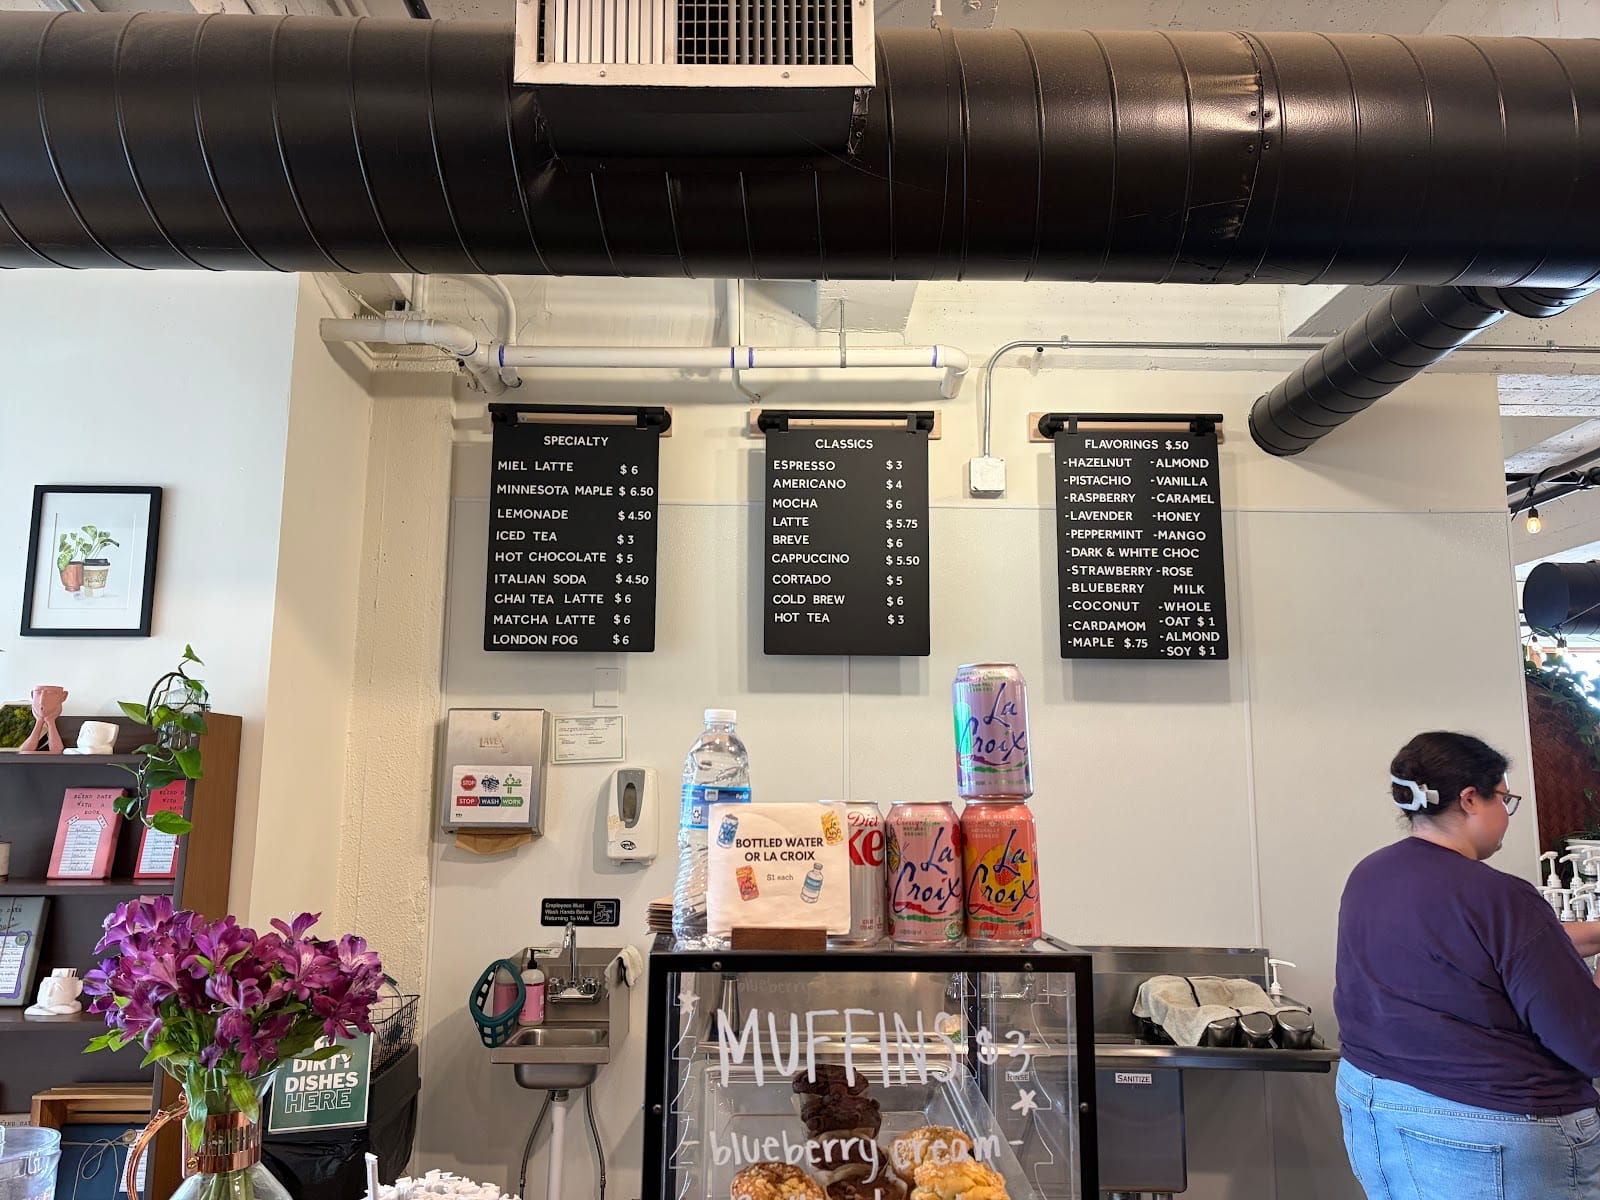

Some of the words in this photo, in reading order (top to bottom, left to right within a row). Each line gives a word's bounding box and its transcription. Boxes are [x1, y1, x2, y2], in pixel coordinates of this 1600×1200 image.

[544, 436, 608, 446] SPECIALTY
[815, 439, 873, 451] CLASSICS
[1085, 439, 1158, 449] FLAVORINGS
[1165, 440, 1189, 450] $.50
[498, 461, 527, 470] MIEL
[535, 461, 573, 471] LATTE
[774, 460, 835, 470] ESPRESSO
[1063, 458, 1132, 467] -HAZELNUT
[1150, 458, 1209, 468] -ALMOND
[773, 479, 846, 489] AMERICANO
[1064, 476, 1131, 485] -PISTACHIO
[1151, 476, 1208, 486] -VANILLA
[497, 485, 569, 495] MINNESOTA
[575, 486, 613, 496] MAPLE
[1064, 493, 1136, 502] -RASPBERRY
[1151, 493, 1214, 504] -CARAMEL
[773, 498, 818, 508] MOCHA
[498, 509, 568, 519] LEMONADE
[1065, 511, 1133, 520] -LAVENDER
[1153, 512, 1200, 521] -HONEY
[773, 517, 809, 526] LATTE
[496, 531, 525, 540] ICED
[533, 532, 557, 541] TEA
[1066, 529, 1143, 539] -PEPPERMINT
[1154, 530, 1206, 540] -MANGO
[773, 535, 809, 544] BREVE
[496, 552, 523, 561] HOT
[529, 552, 606, 562] CHOCOLATE
[1066, 547, 1103, 557] -DARK
[1107, 547, 1115, 557] &
[1119, 548, 1159, 557] WHITE
[1163, 548, 1199, 558] CHOC
[772, 554, 849, 563] CAPPUCCINO
[1067, 565, 1153, 576] -STRAWBERRY
[1156, 567, 1193, 576] -ROSE
[495, 574, 545, 584] ITALIAN
[553, 574, 586, 584] SODA
[773, 575, 831, 584] CORTADO
[1067, 583, 1144, 593] -BLUEBERRY
[1174, 584, 1204, 594] MILK
[495, 594, 525, 603] CHAI
[530, 594, 554, 604] TEA
[565, 594, 603, 603] LATTE
[773, 594, 806, 604] COLD
[813, 595, 845, 604] BREW
[1068, 601, 1139, 611] -COCONUT
[1159, 602, 1211, 611] -WHOLE
[494, 615, 548, 624] MATCHA
[556, 615, 595, 624] LATTE
[775, 613, 800, 622] HOT
[807, 613, 830, 622] TEA
[1160, 616, 1190, 626] -OAT
[1068, 621, 1146, 631] -CARDAMOM
[493, 635, 547, 644] LONDON
[552, 635, 578, 645] FOG
[1160, 632, 1220, 641] -ALMOND
[1068, 637, 1114, 647] -MAPLE
[1124, 637, 1148, 648] $.75
[1161, 646, 1191, 656] -SOY
[983, 682, 1017, 727] La
[959, 717, 1025, 761] Croix
[848, 812, 878, 826] Diet
[736, 838, 782, 848] BOTTLED
[786, 838, 824, 847] WATER
[849, 829, 884, 866] ke
[745, 852, 760, 861] OR
[764, 852, 776, 861] LA
[781, 851, 815, 861] CROIX
[921, 827, 954, 875] La
[993, 829, 1027, 876] La
[892, 862, 960, 914] Croix
[967, 864, 1035, 914] Croix
[717, 1007, 958, 1088] MUFFINS
[293, 1053, 353, 1073] DIRTY
[285, 1072, 358, 1093] DISHES
[1117, 1074, 1151, 1083] SANITIZE
[285, 1088, 351, 1113] HERE
[709, 1130, 879, 1184] blueberry
[893, 1131, 1000, 1170] cream
